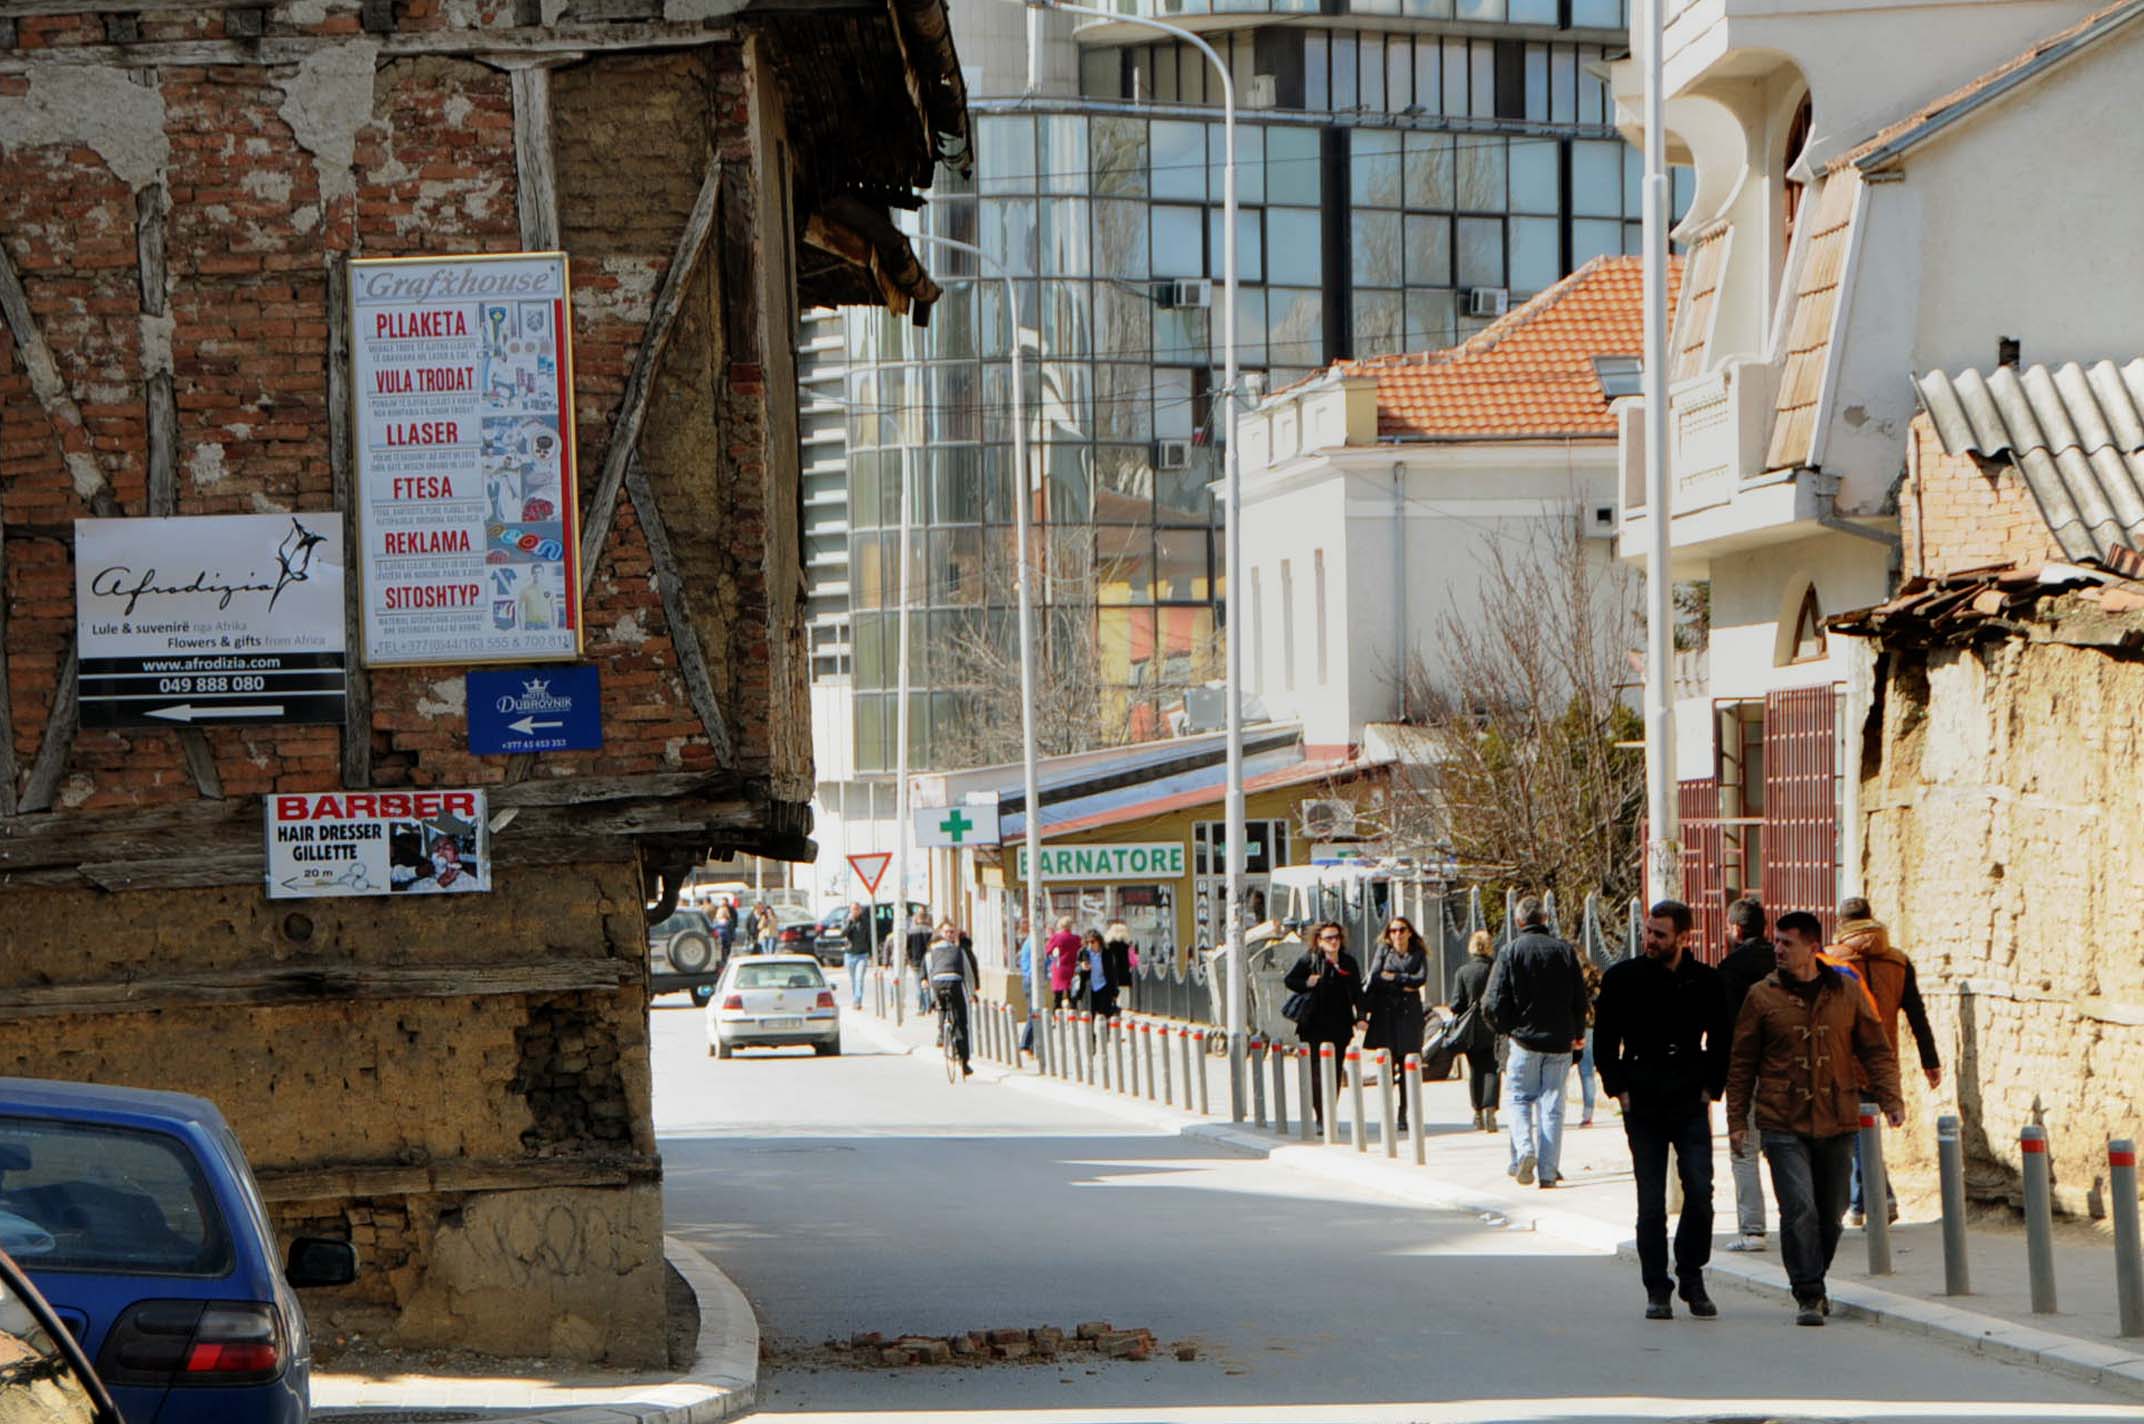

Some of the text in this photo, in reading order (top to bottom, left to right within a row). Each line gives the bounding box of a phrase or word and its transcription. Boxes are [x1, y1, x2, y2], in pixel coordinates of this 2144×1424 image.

[376, 310, 467, 338] PLLAKETA
[376, 367, 474, 393] VULA TRODAT
[386, 421, 459, 446] LLASER
[393, 476, 453, 500] FTESA
[385, 530, 470, 555] REKLAMA
[92, 566, 274, 616] Afrodizia
[385, 584, 480, 609] SITOSHTYP
[93, 623, 118, 636] Lule
[122, 623, 131, 634] &
[136, 621, 190, 634] suvenirë
[168, 636, 217, 649] Flowers
[221, 636, 230, 647] &
[234, 635, 262, 650] gifts
[142, 657, 281, 672] www.afrodizia.com
[159, 676, 265, 693] 049 888 080
[496, 695, 572, 713] DUBROVNIK
[277, 792, 476, 821] BARBER
[278, 824, 382, 842] HAIR DRESSER
[293, 845, 357, 861] GILLETTE
[304, 869, 320, 878] 20
